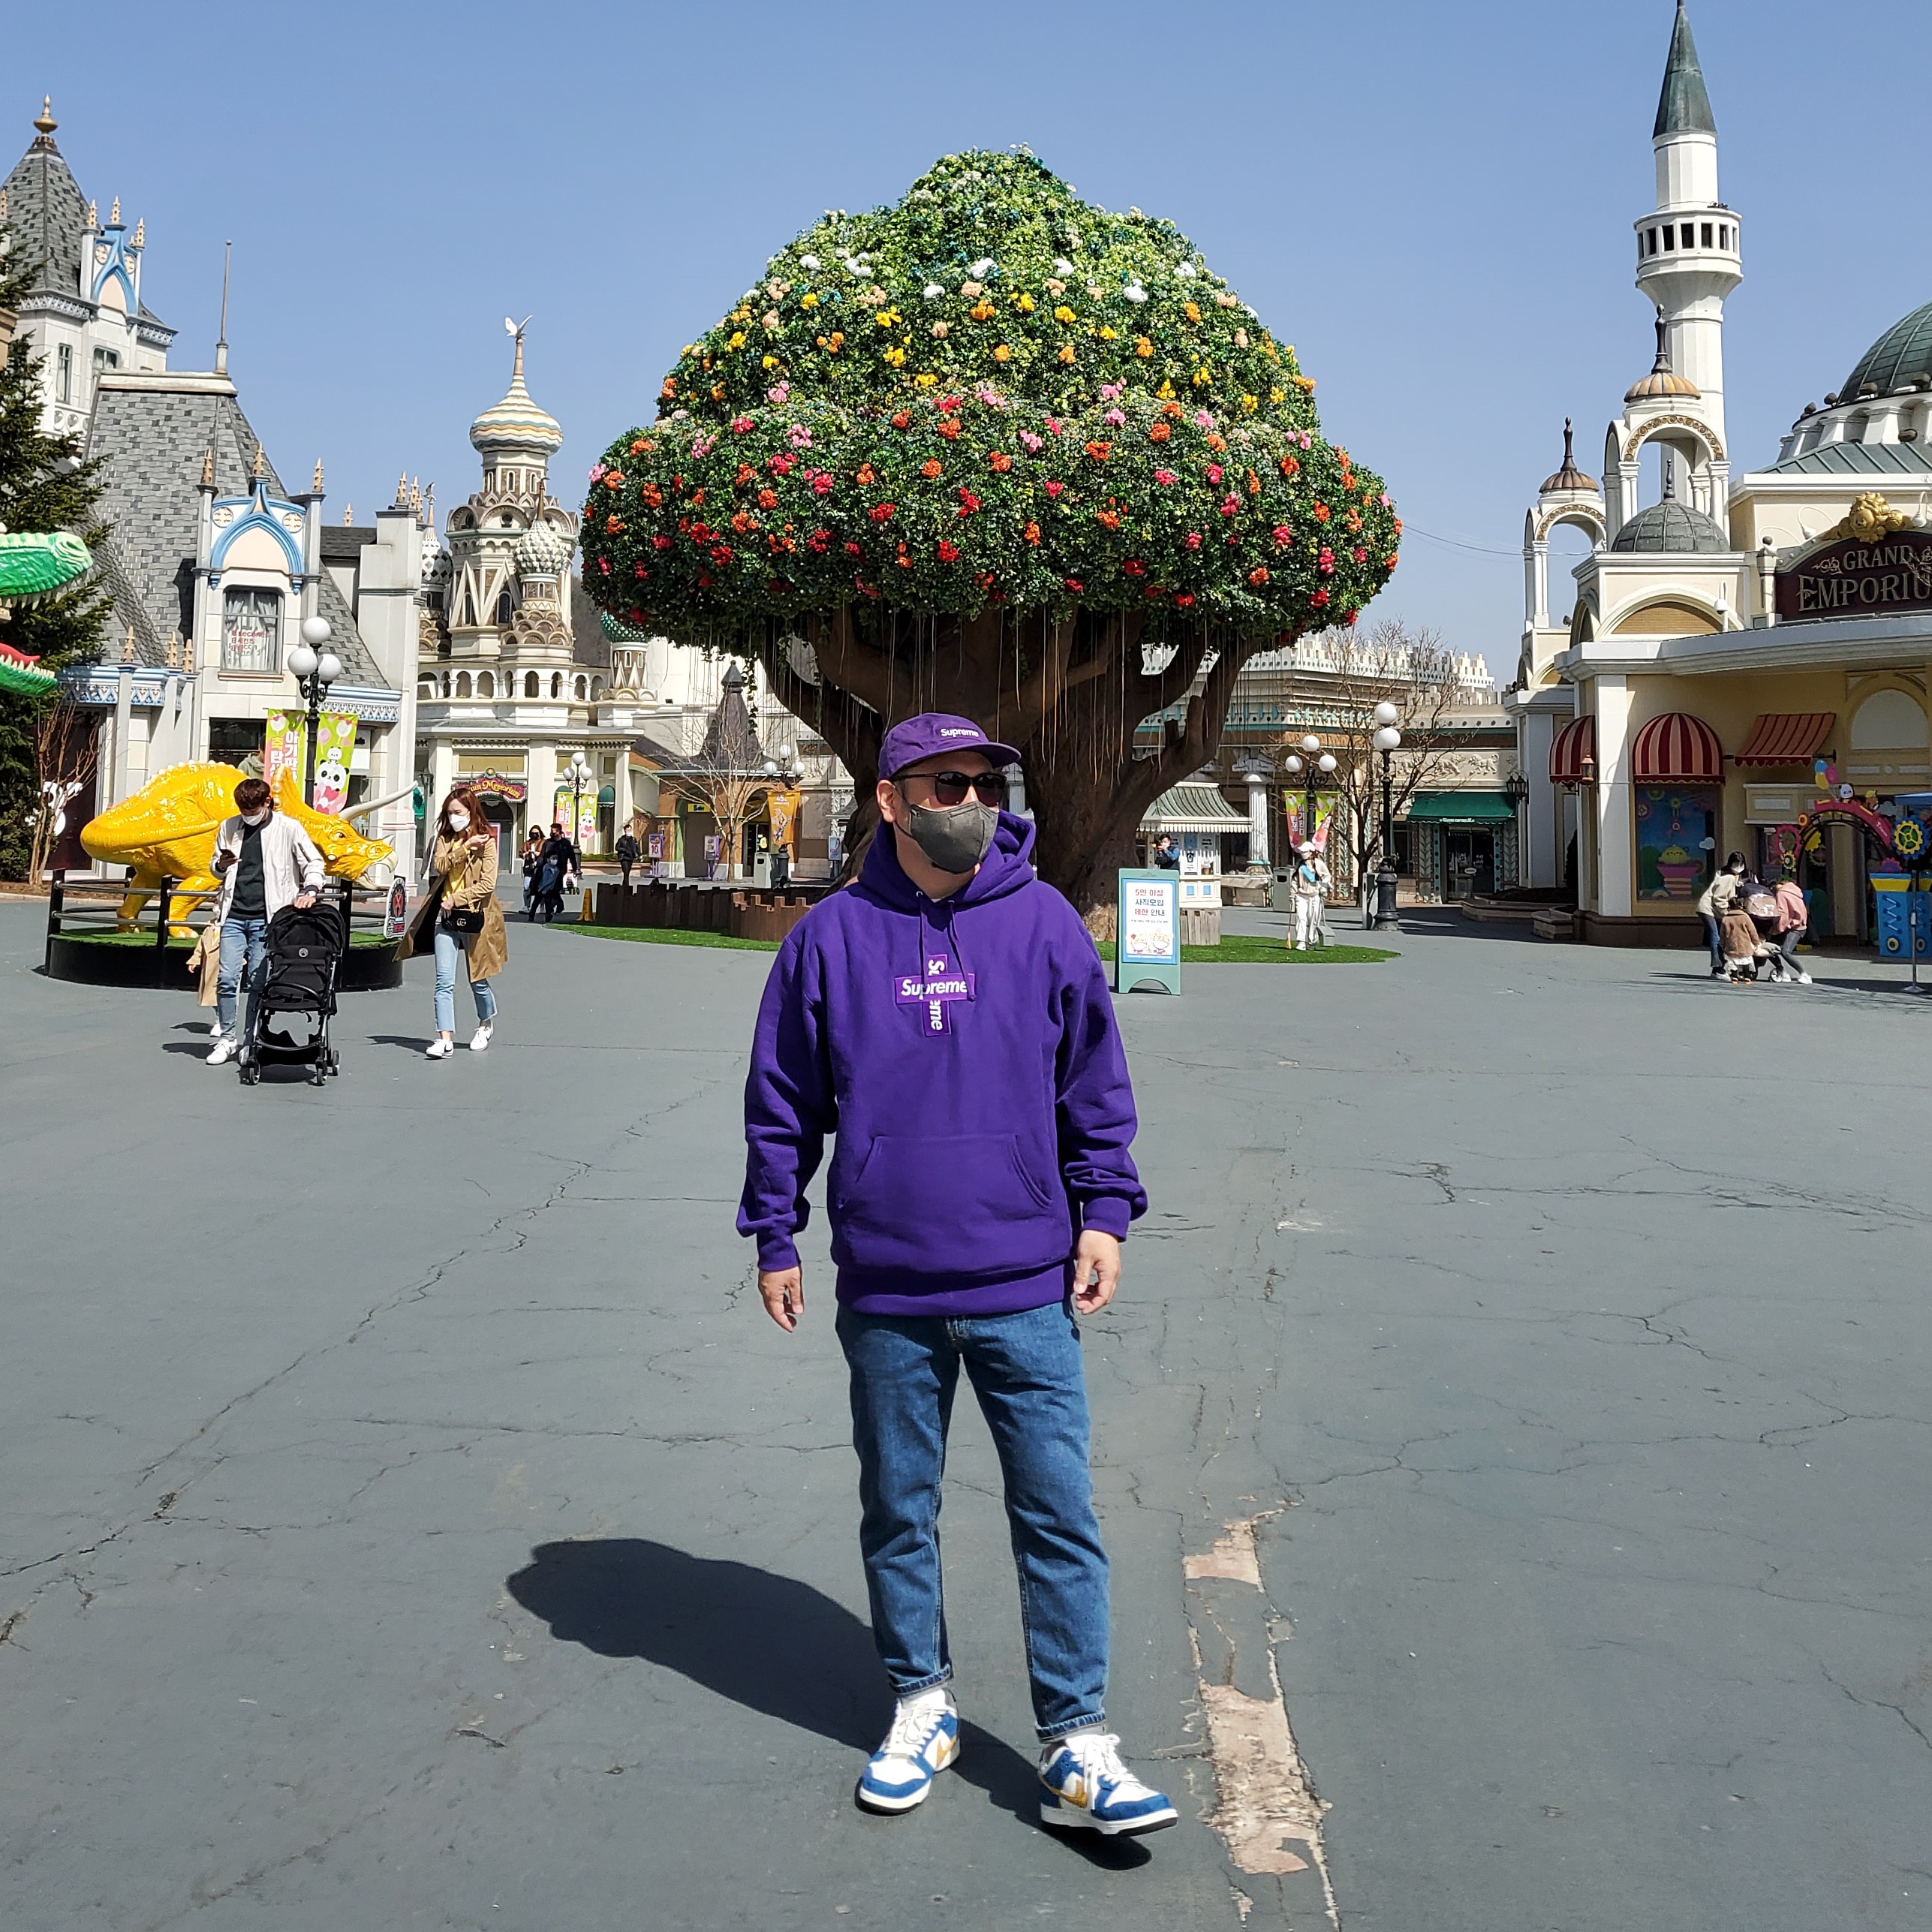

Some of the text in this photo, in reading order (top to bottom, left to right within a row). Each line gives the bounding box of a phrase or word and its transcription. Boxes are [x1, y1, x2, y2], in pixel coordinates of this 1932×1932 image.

[1843, 546, 1914, 570] GRAND
[940, 728, 979, 737] Supreme
[901, 979, 968, 1000] Supreme
